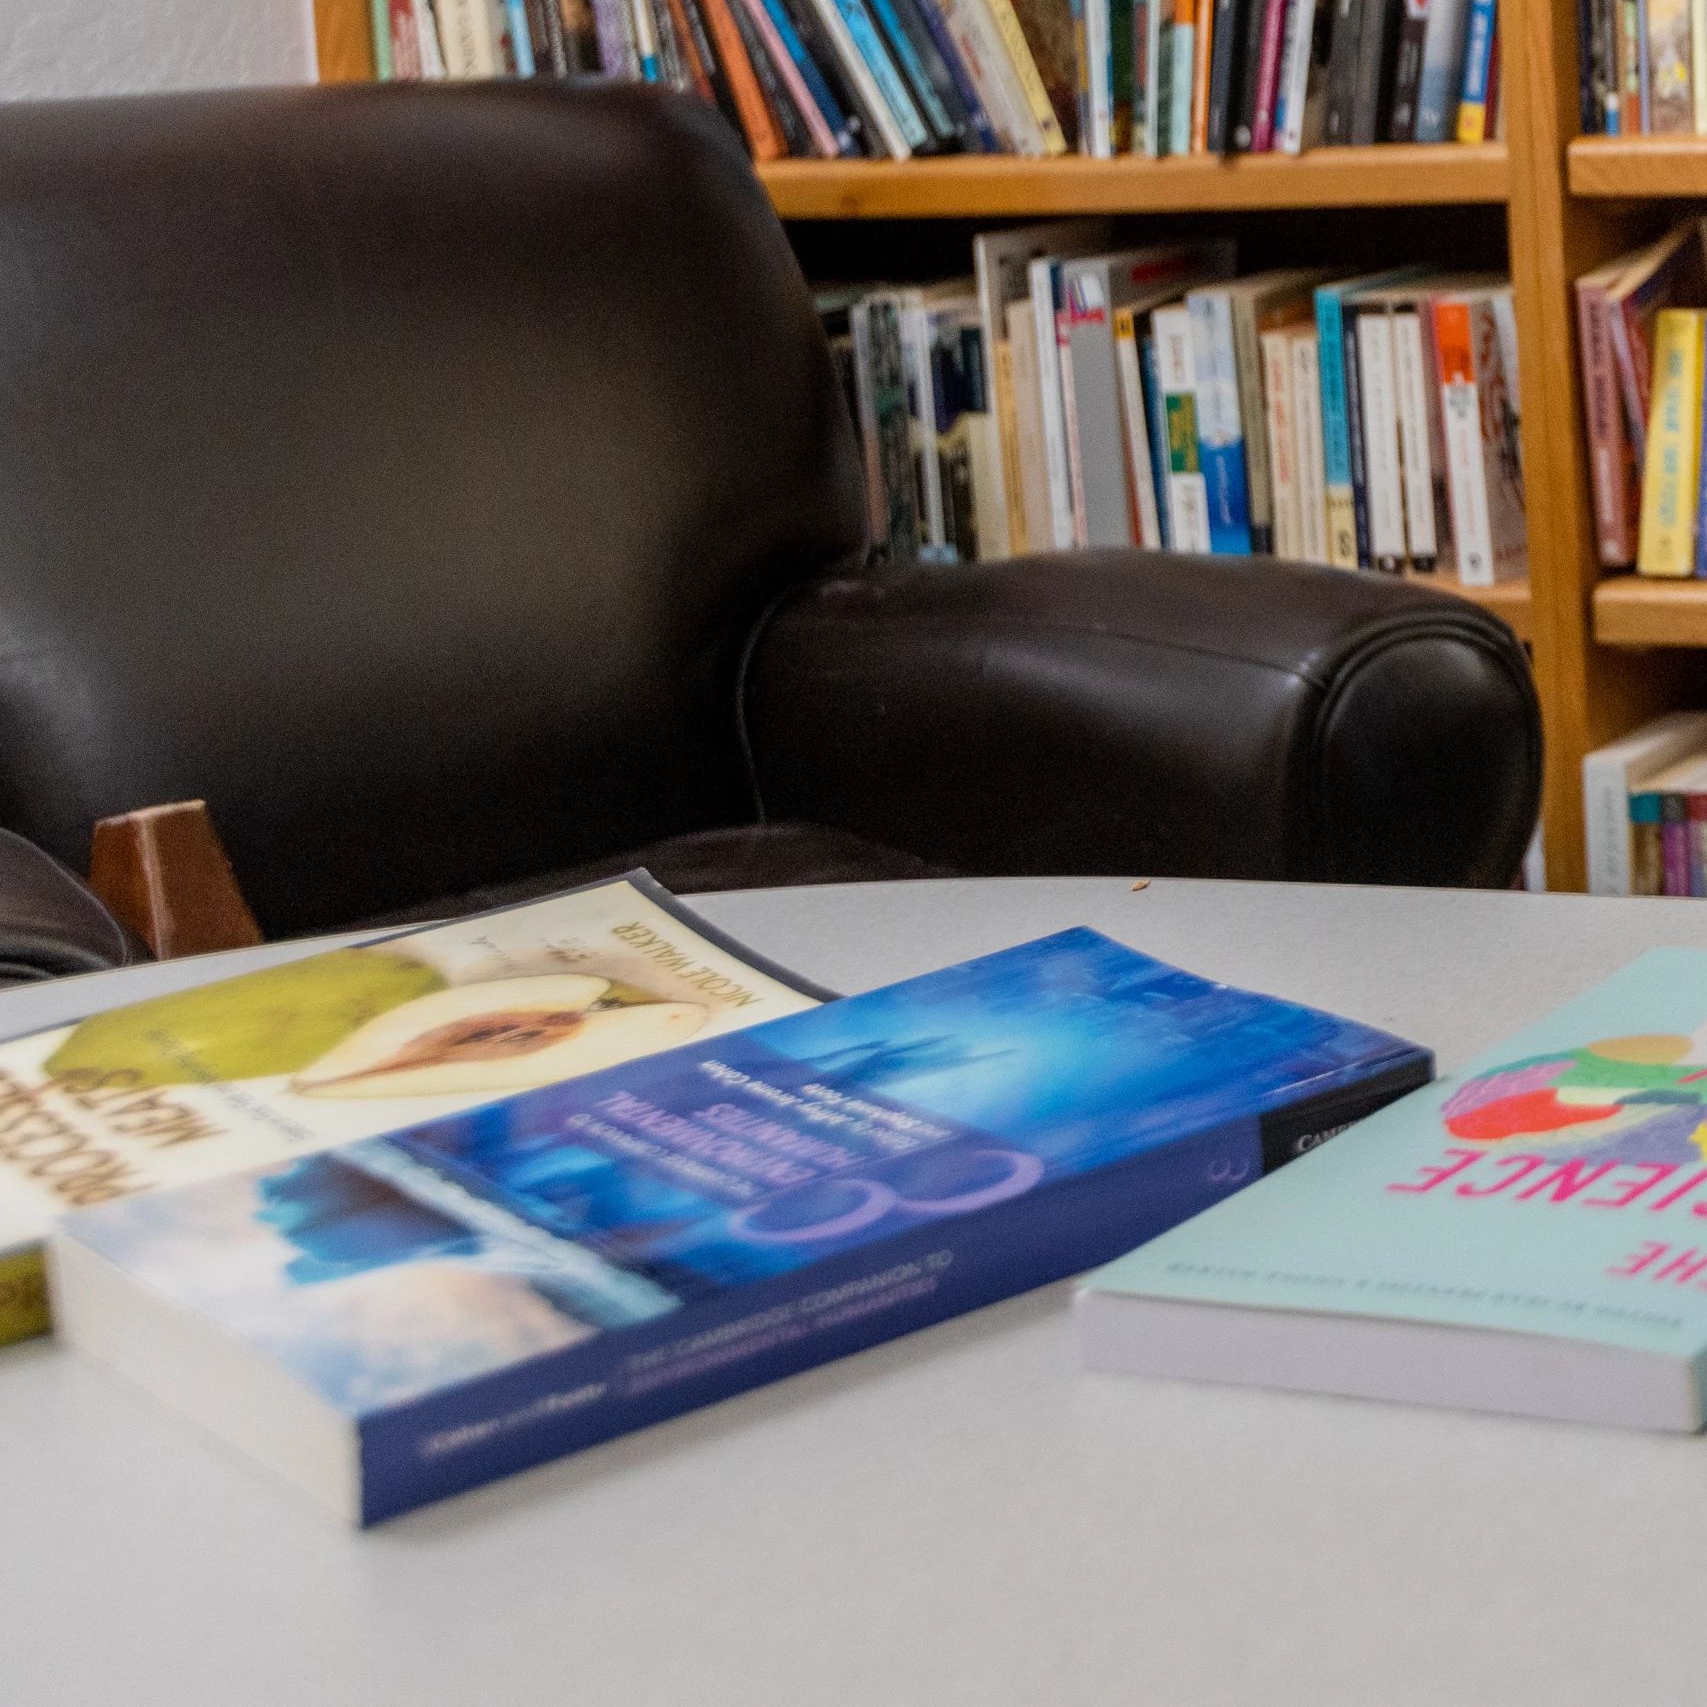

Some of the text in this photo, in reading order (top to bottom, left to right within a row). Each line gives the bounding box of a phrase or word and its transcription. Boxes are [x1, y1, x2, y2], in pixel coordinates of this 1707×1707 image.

[611, 921, 698, 973] WALKER
[677, 967, 765, 1009] NICOLE
[58, 1066, 229, 1152] MEATS
